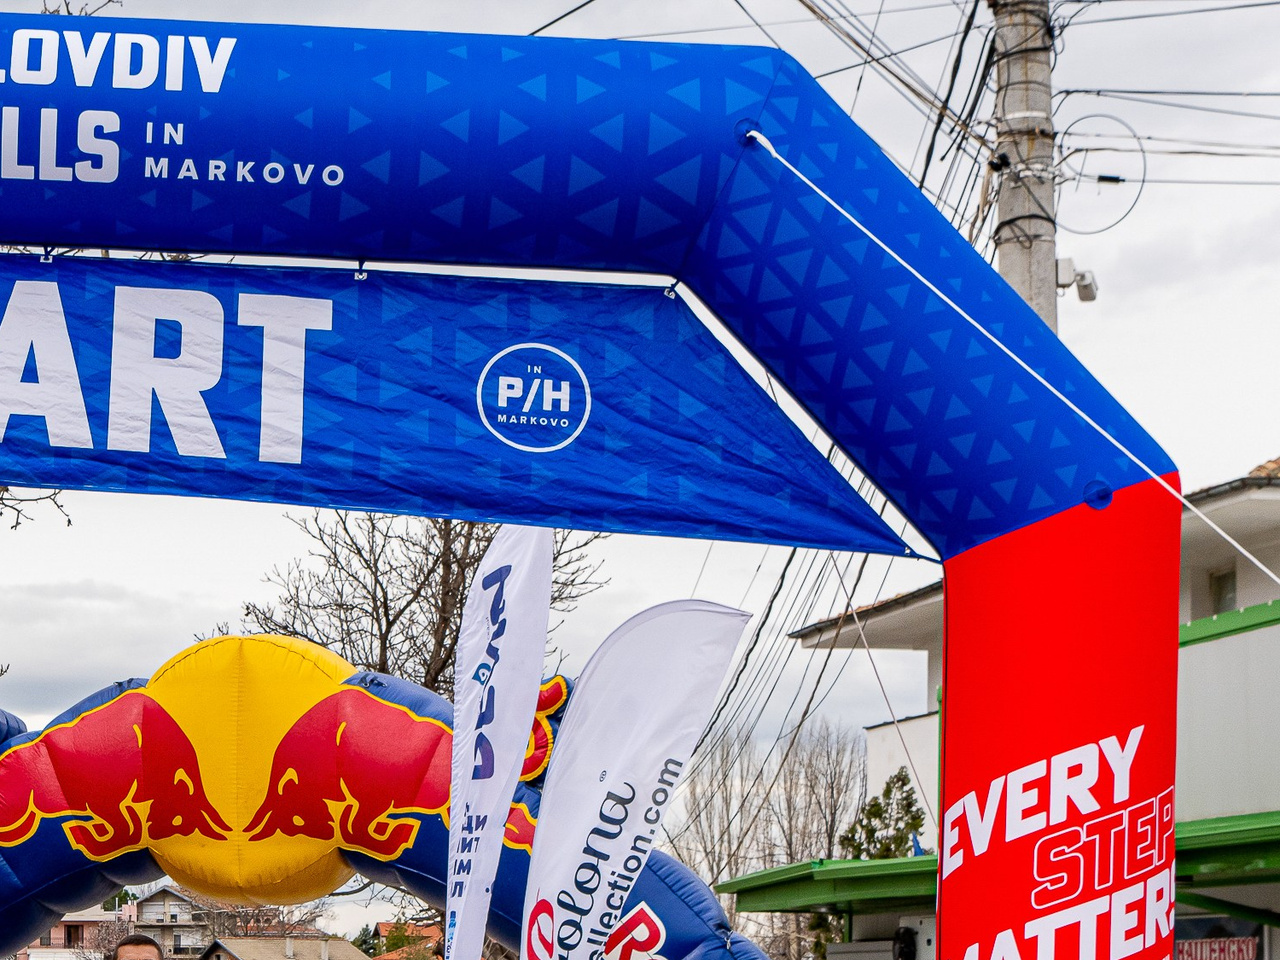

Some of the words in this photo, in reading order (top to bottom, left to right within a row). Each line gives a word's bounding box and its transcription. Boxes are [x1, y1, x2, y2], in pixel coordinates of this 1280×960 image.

[146, 121, 184, 145] IN
[144, 157, 345, 186] MARKOVO
[527, 365, 542, 374] IN
[497, 376, 571, 413] P/H
[497, 414, 570, 428] MARKOVO
[942, 725, 1145, 880] EVERY
[1031, 785, 1175, 910] STEP
